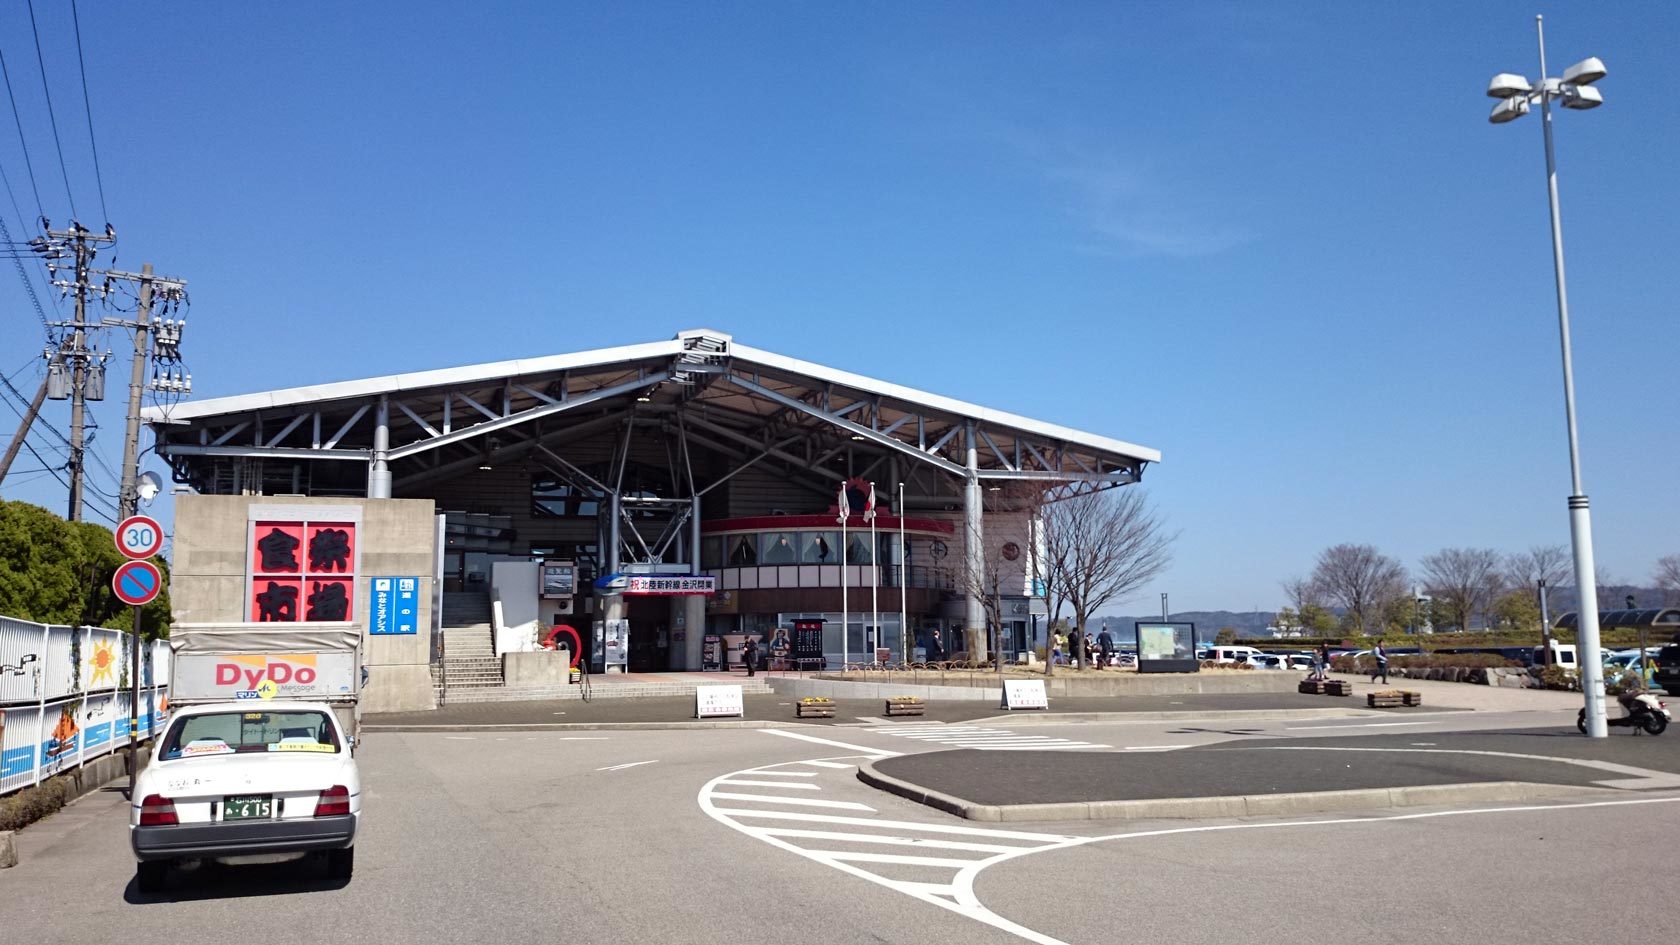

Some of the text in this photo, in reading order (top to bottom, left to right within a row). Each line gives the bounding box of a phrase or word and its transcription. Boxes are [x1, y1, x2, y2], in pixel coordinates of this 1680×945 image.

[127, 528, 152, 547] 30
[630, 579, 713, 590] 祝 北陸新幹線 金沢開業
[377, 592, 387, 632] みなとオアシス
[400, 592, 412, 632] 道の駅
[216, 662, 316, 690] DyDo
